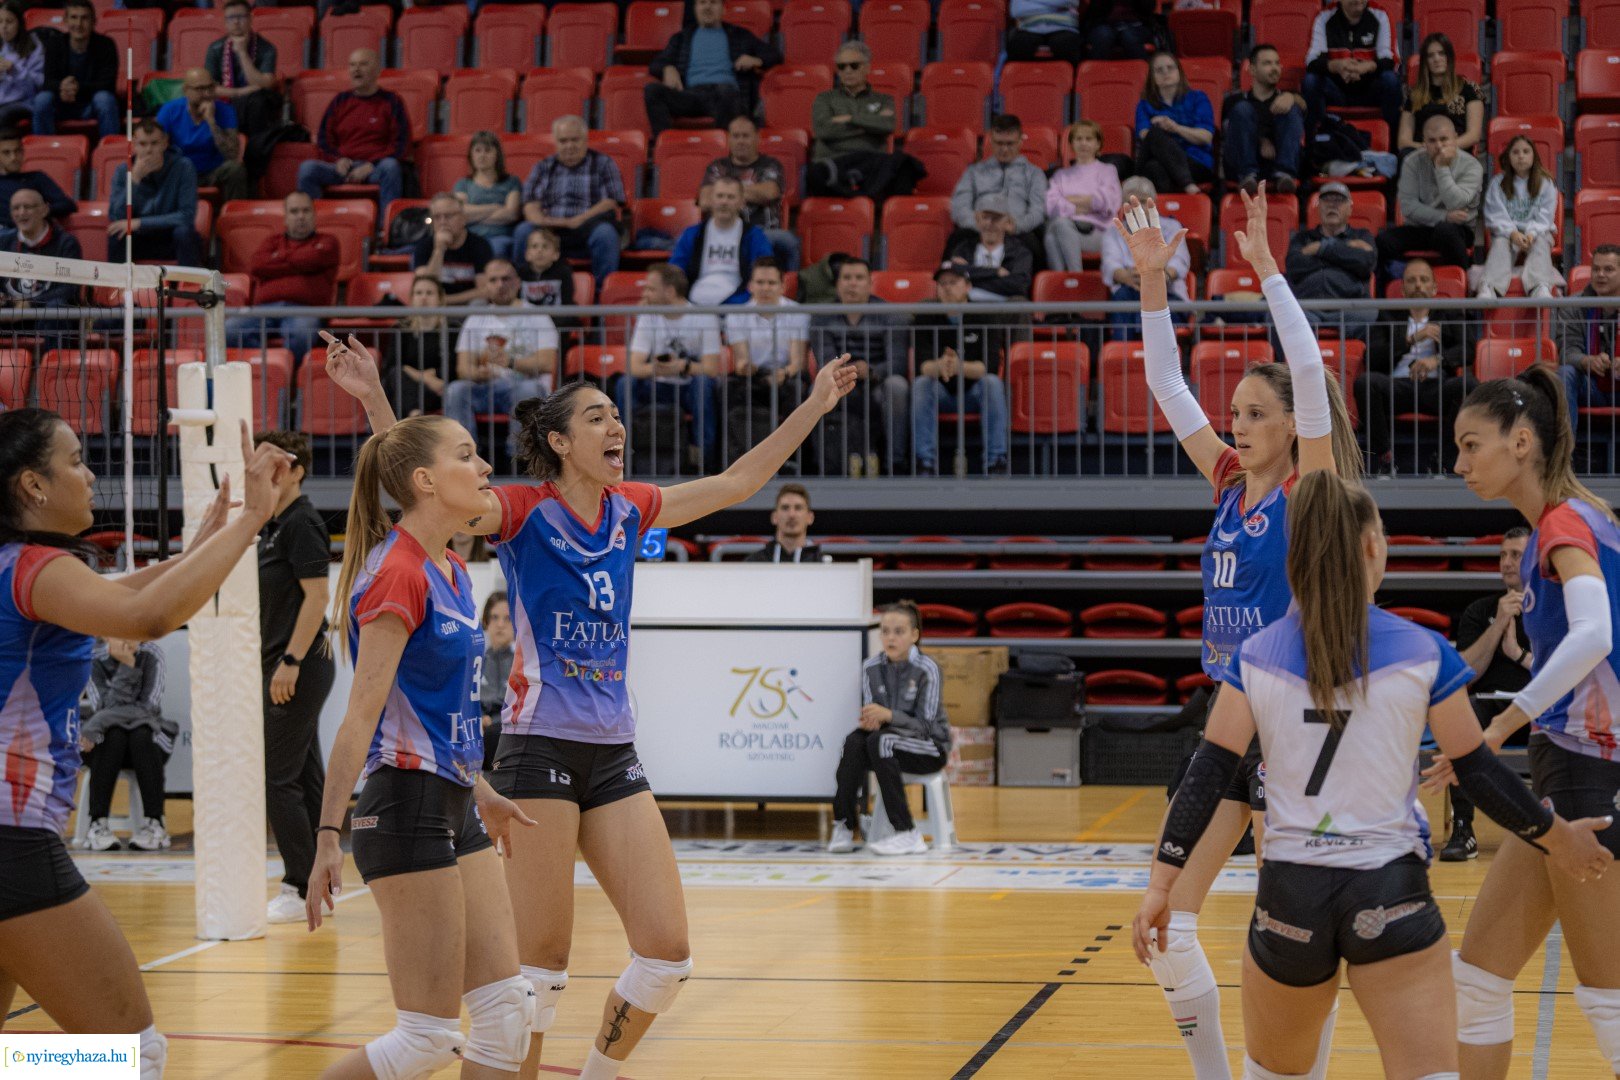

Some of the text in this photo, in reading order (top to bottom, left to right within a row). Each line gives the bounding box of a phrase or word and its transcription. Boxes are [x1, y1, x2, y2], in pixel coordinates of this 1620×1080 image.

[582, 570, 615, 611] 13
[1212, 551, 1237, 588] 10
[1204, 596, 1265, 627] ATUM
[470, 655, 483, 702] 3
[729, 666, 788, 720] 75
[1303, 709, 1353, 797] 7
